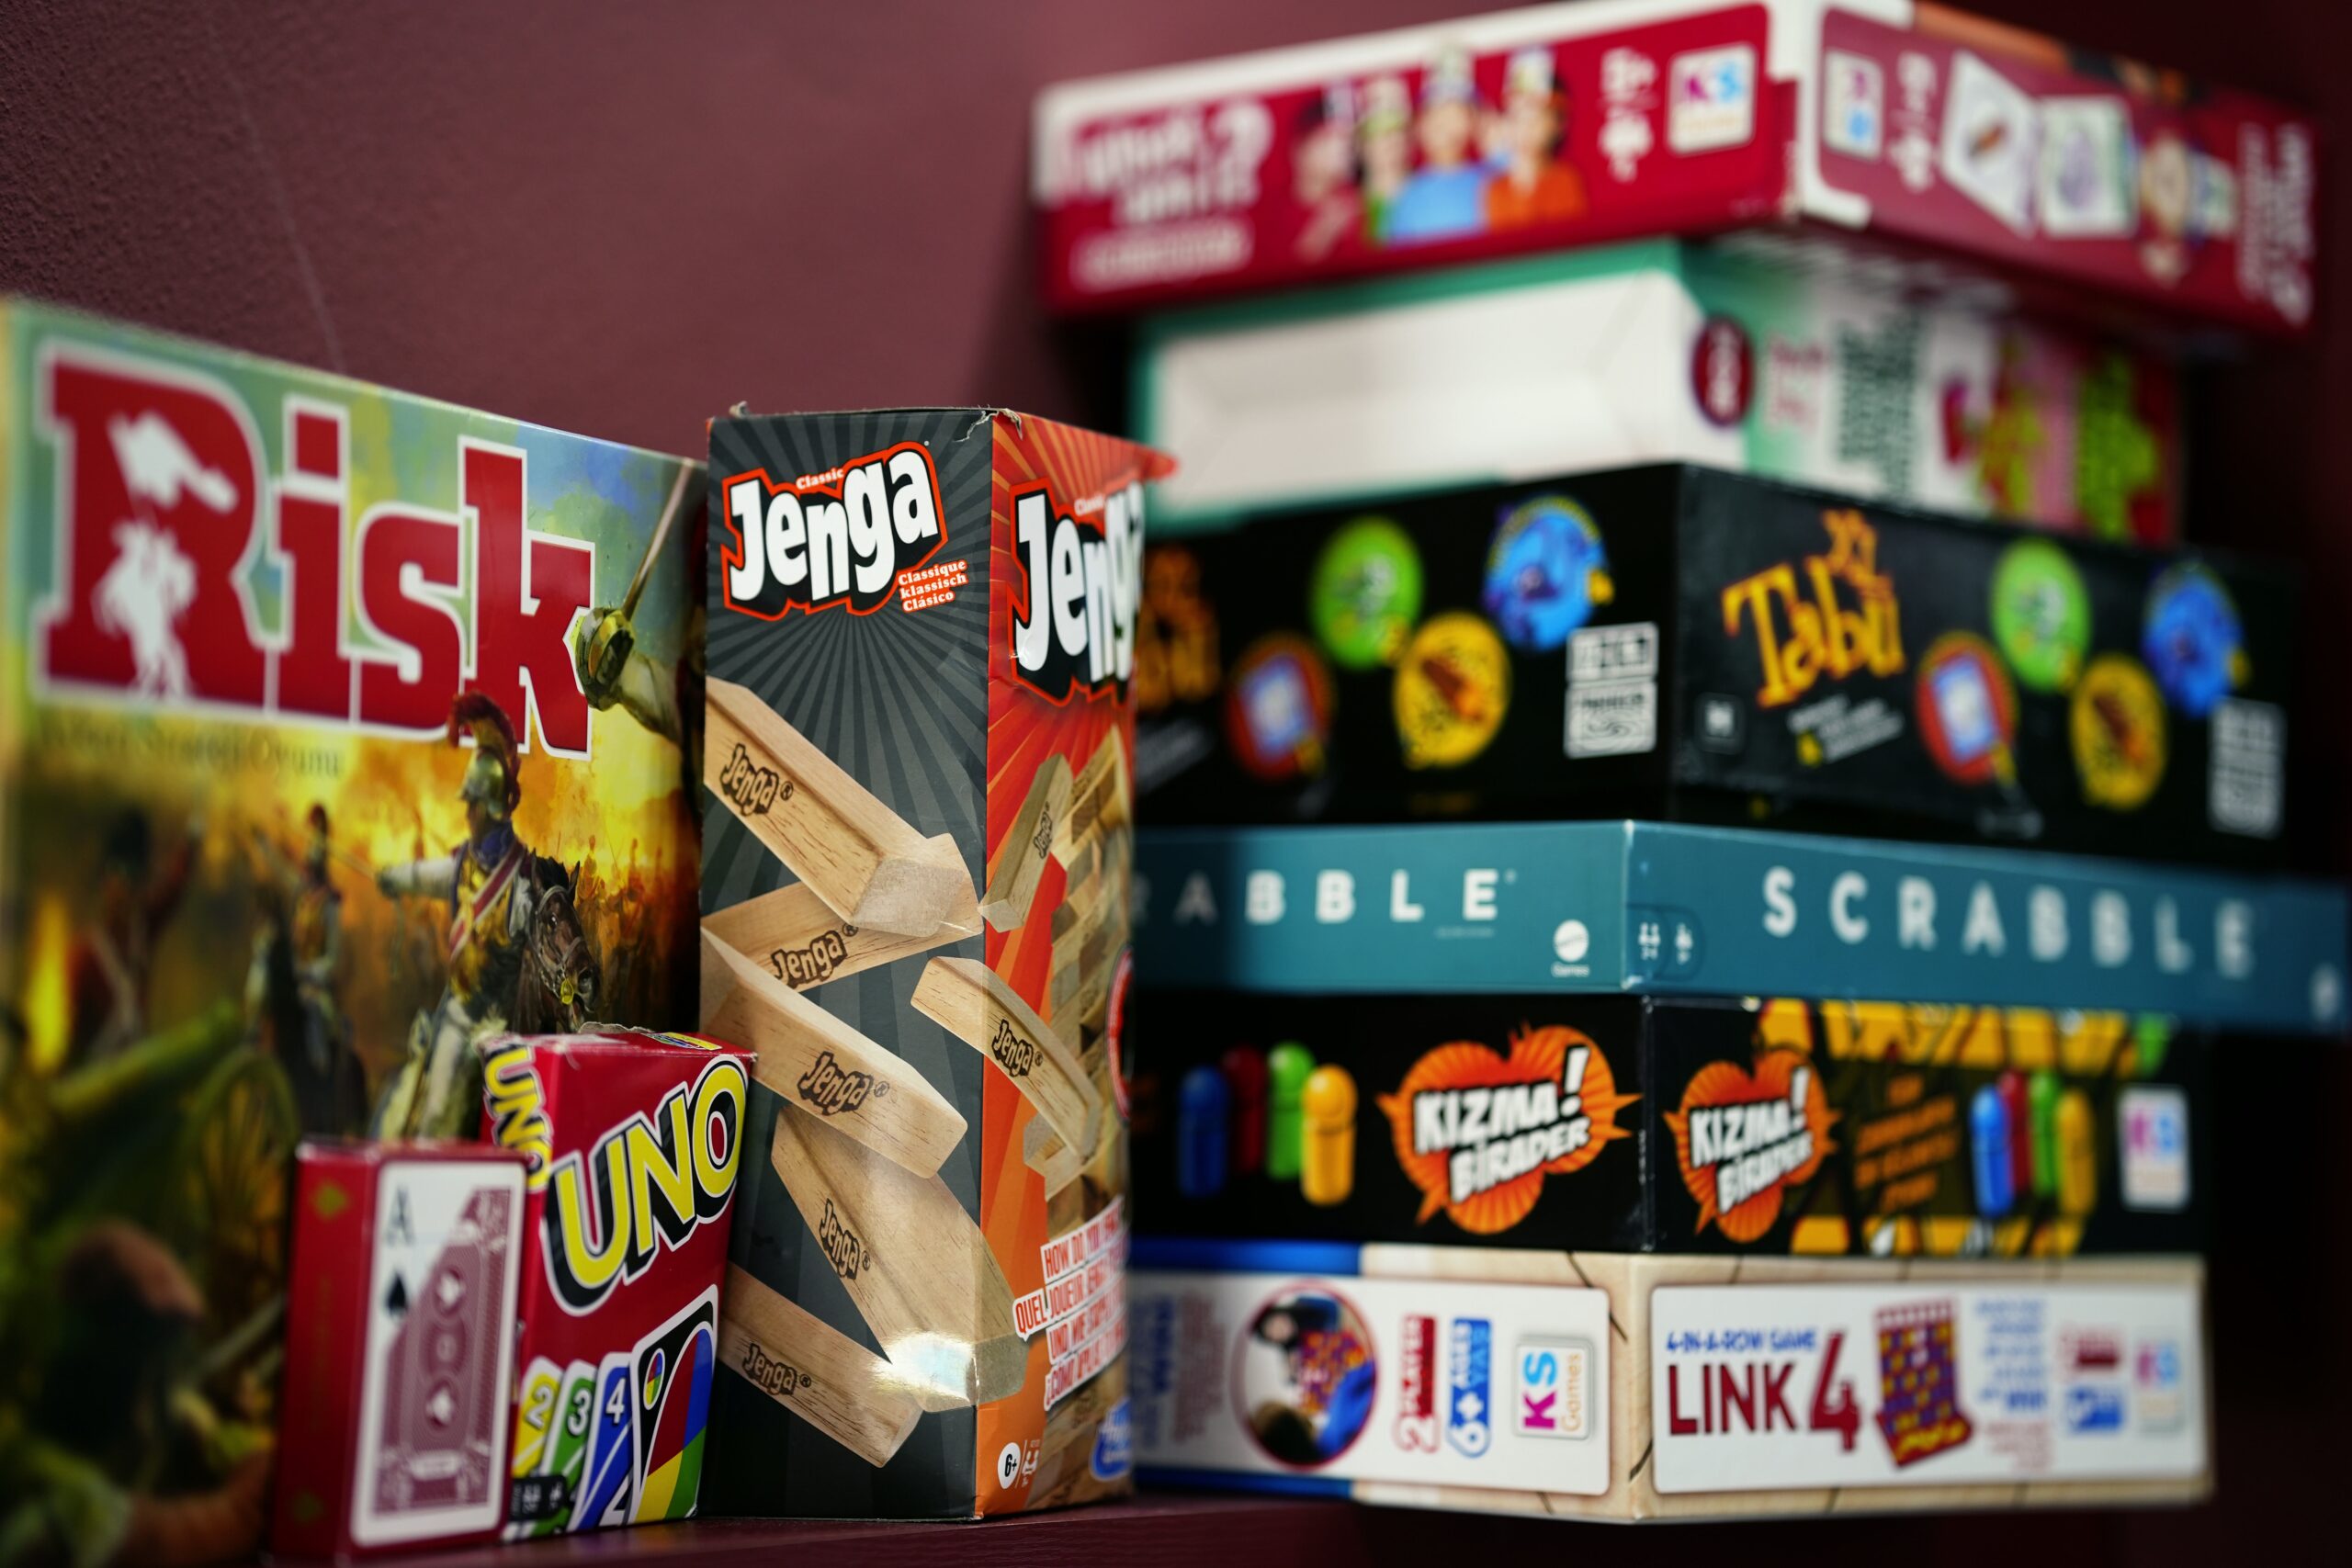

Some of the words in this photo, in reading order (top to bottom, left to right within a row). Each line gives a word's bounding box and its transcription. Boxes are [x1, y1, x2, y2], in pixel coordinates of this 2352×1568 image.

[796, 468, 844, 491] Classic
[729, 450, 939, 601] Jenga
[39, 349, 594, 755] Risk
[898, 559, 967, 586] Classique
[899, 573, 967, 600] klassisch
[901, 591, 954, 612] Clásico
[1760, 864, 2256, 981] SCRABBLE
[547, 1058, 748, 1306] UNO
[1015, 1296, 1047, 1335] QUEL
[525, 1385, 551, 1429] 2
[567, 1387, 593, 1437] 3
[605, 1378, 626, 1425] 4
[1522, 1351, 1558, 1430] KS
[1561, 1352, 1582, 1433] Games
[1668, 1362, 1797, 1436] LINK
[1806, 1329, 1861, 1452] 4
[1396, 1415, 1438, 1451] 2
[1005, 1453, 1017, 1478] 6+
